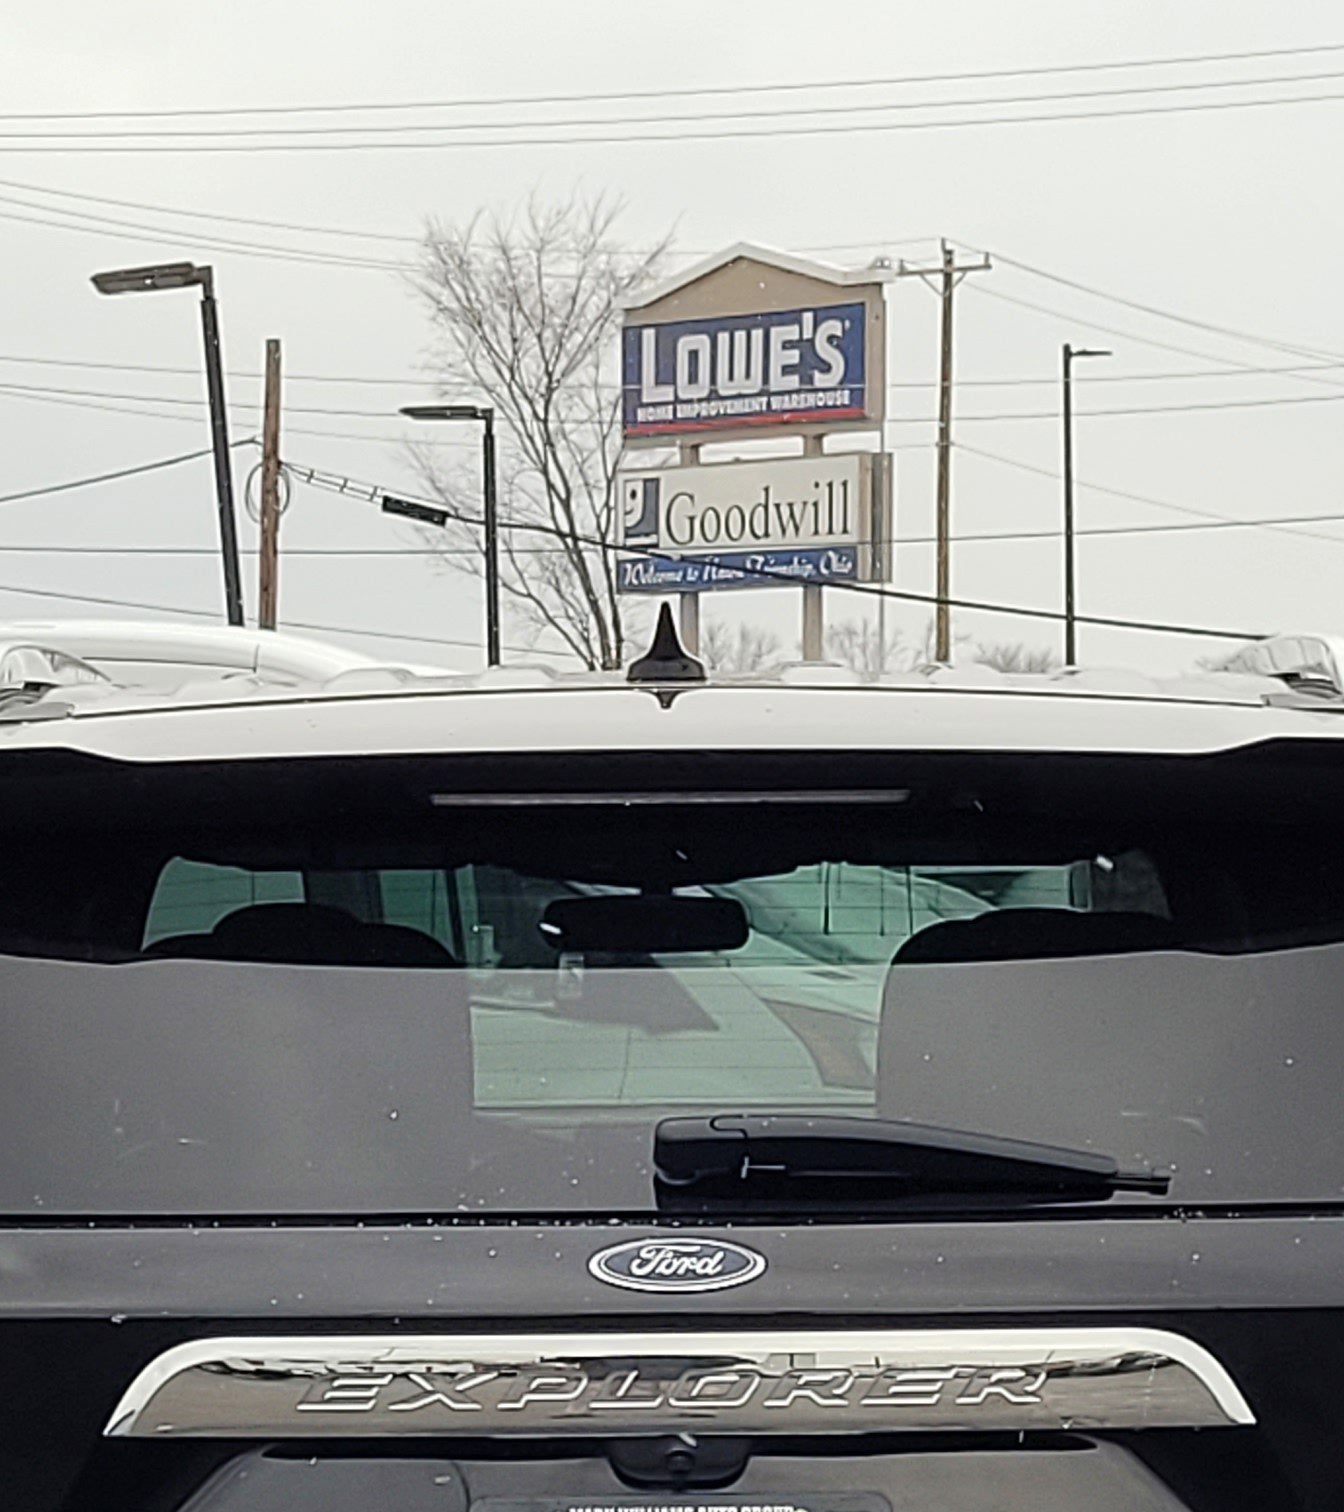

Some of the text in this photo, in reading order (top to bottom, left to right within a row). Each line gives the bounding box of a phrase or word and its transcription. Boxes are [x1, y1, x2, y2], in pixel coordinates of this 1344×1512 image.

[641, 311, 846, 403] LOWE'S
[637, 390, 850, 423] HOME IMPROVEMENT WAREHOUSE
[665, 479, 849, 546] Goodwill
[629, 1244, 725, 1276] Ford
[294, 1367, 1050, 1412] EXPLORER
